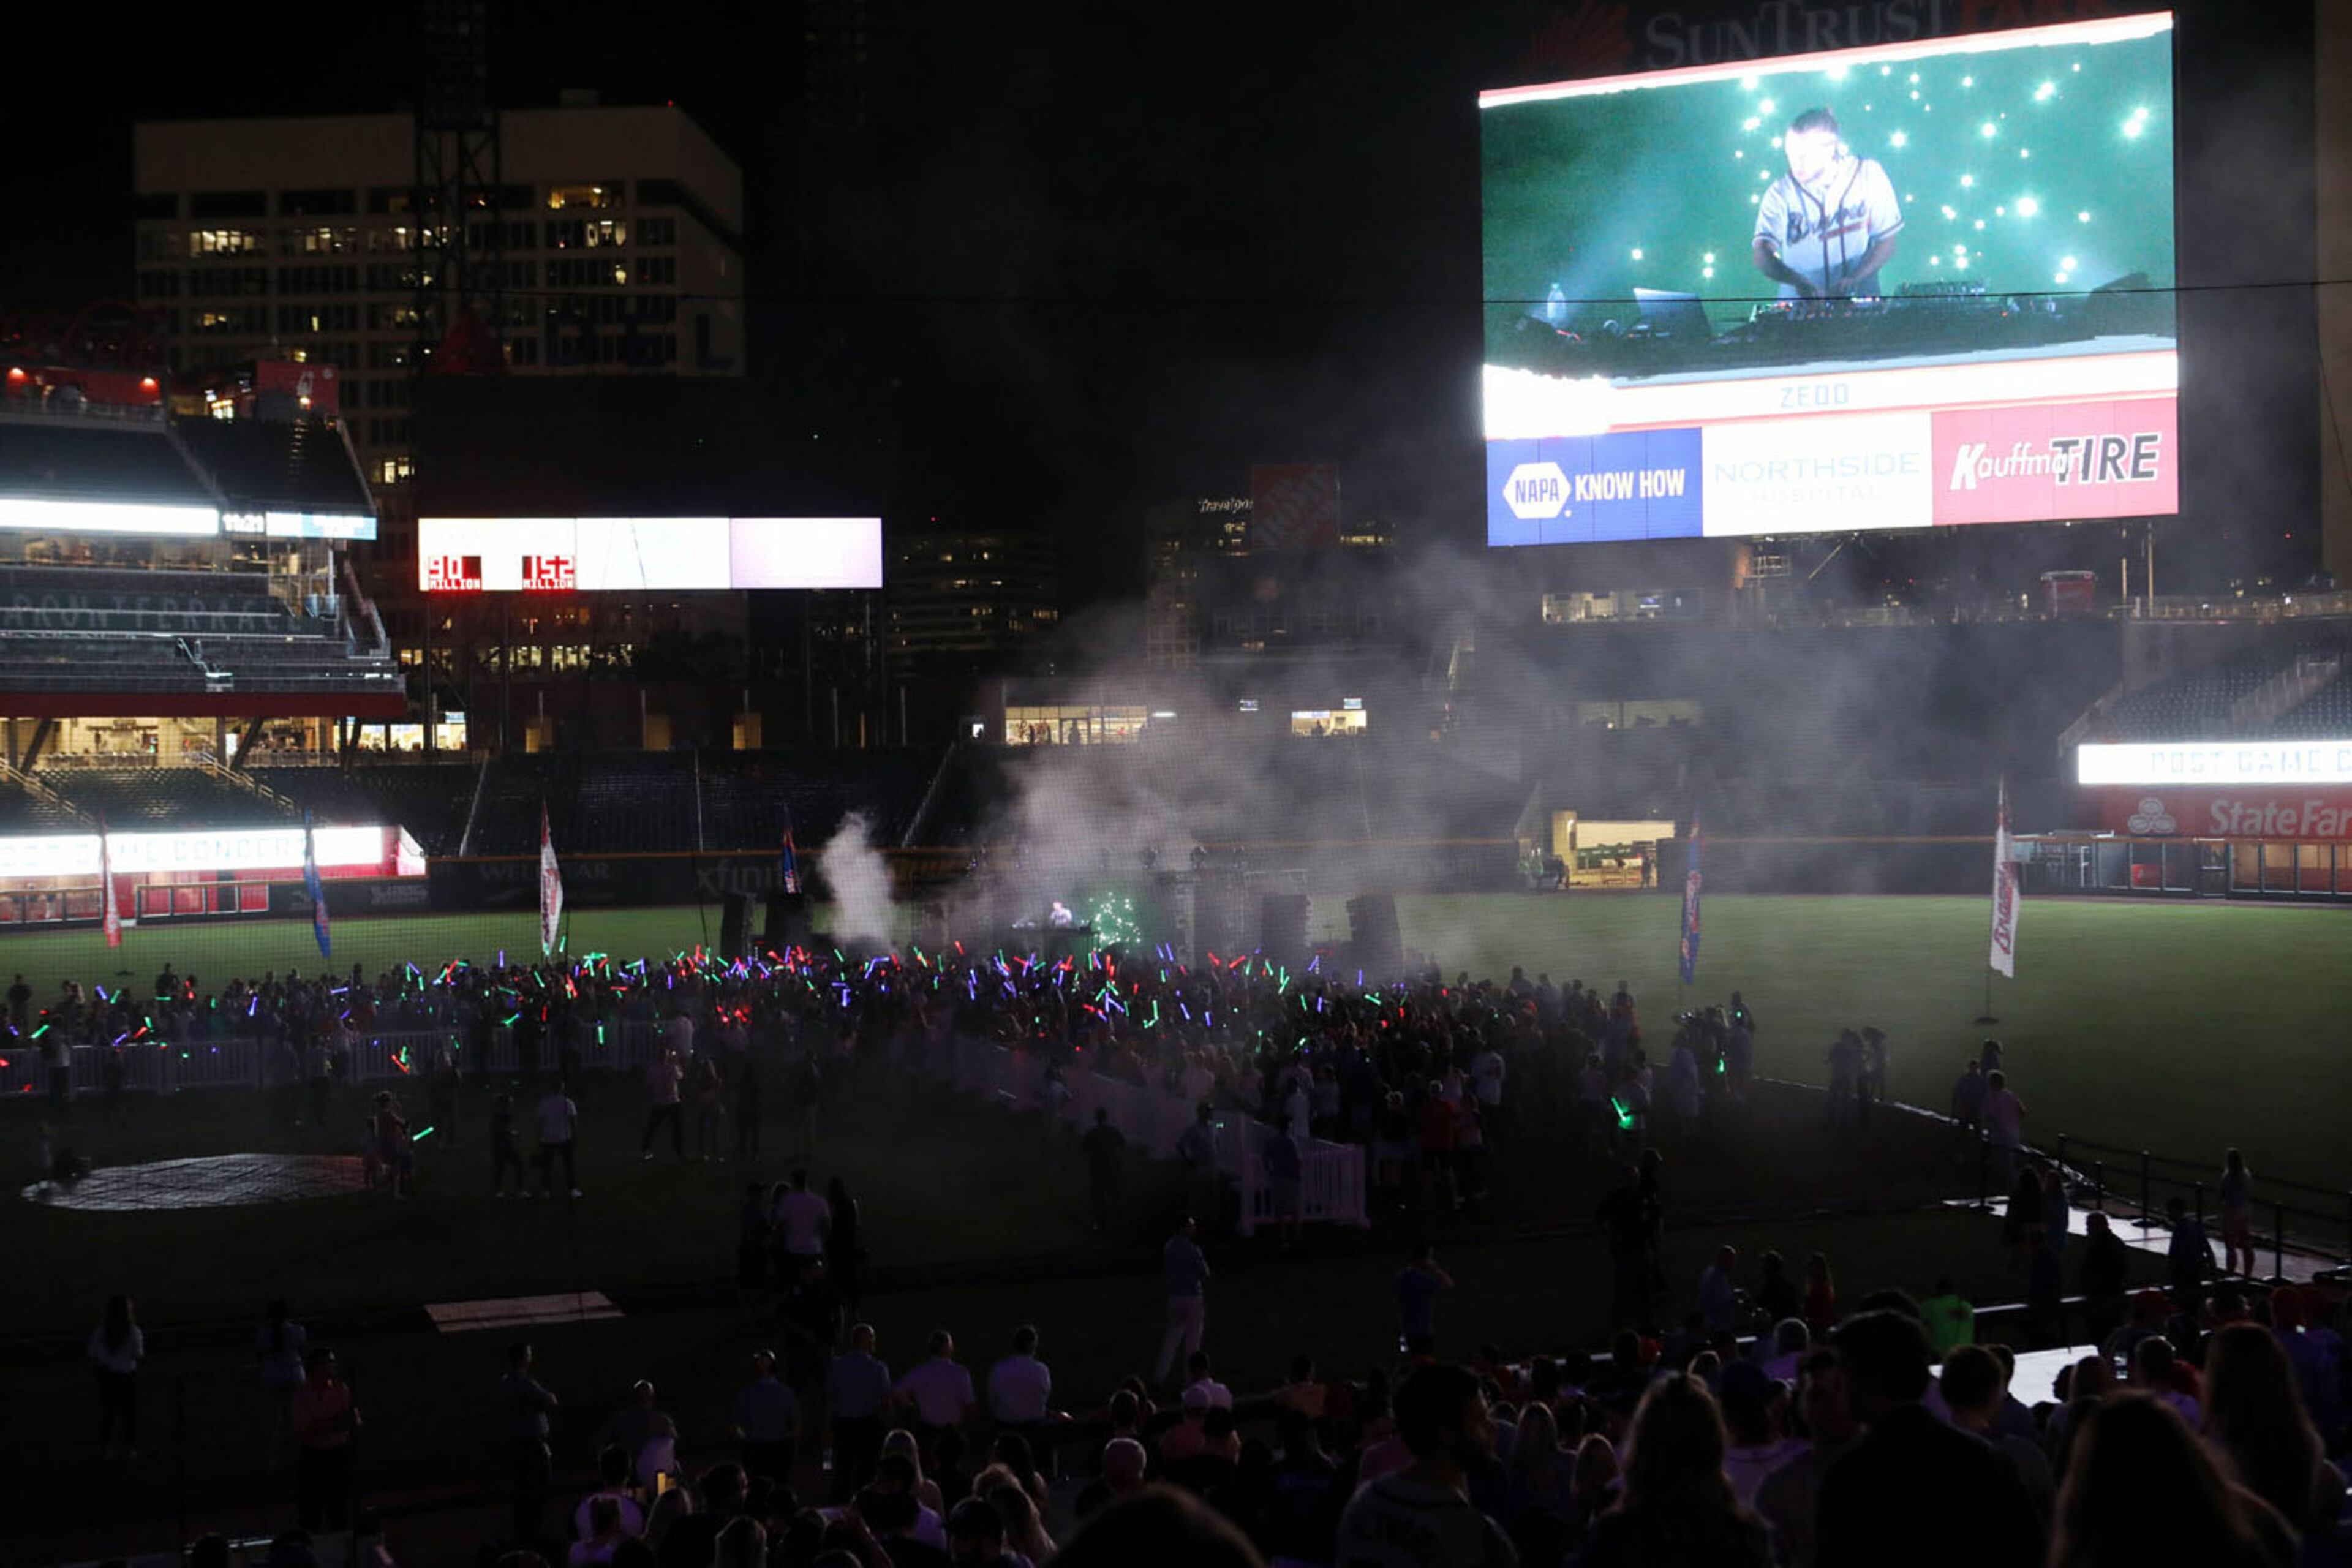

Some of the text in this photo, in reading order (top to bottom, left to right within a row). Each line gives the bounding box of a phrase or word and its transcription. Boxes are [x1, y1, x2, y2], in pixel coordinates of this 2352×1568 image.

[1714, 452, 1920, 484] NORTHSIDE
[2052, 432, 2161, 484] TIRE
[1515, 478, 1560, 504] NAPA
[1575, 469, 1685, 502] KNOW HOW
[429, 556, 462, 579] 90
[531, 556, 575, 579] 152
[430, 579, 481, 589] MILLION
[523, 579, 575, 589] MILLION
[0, 594, 108, 628] ARON
[2300, 800, 2352, 836] Far
